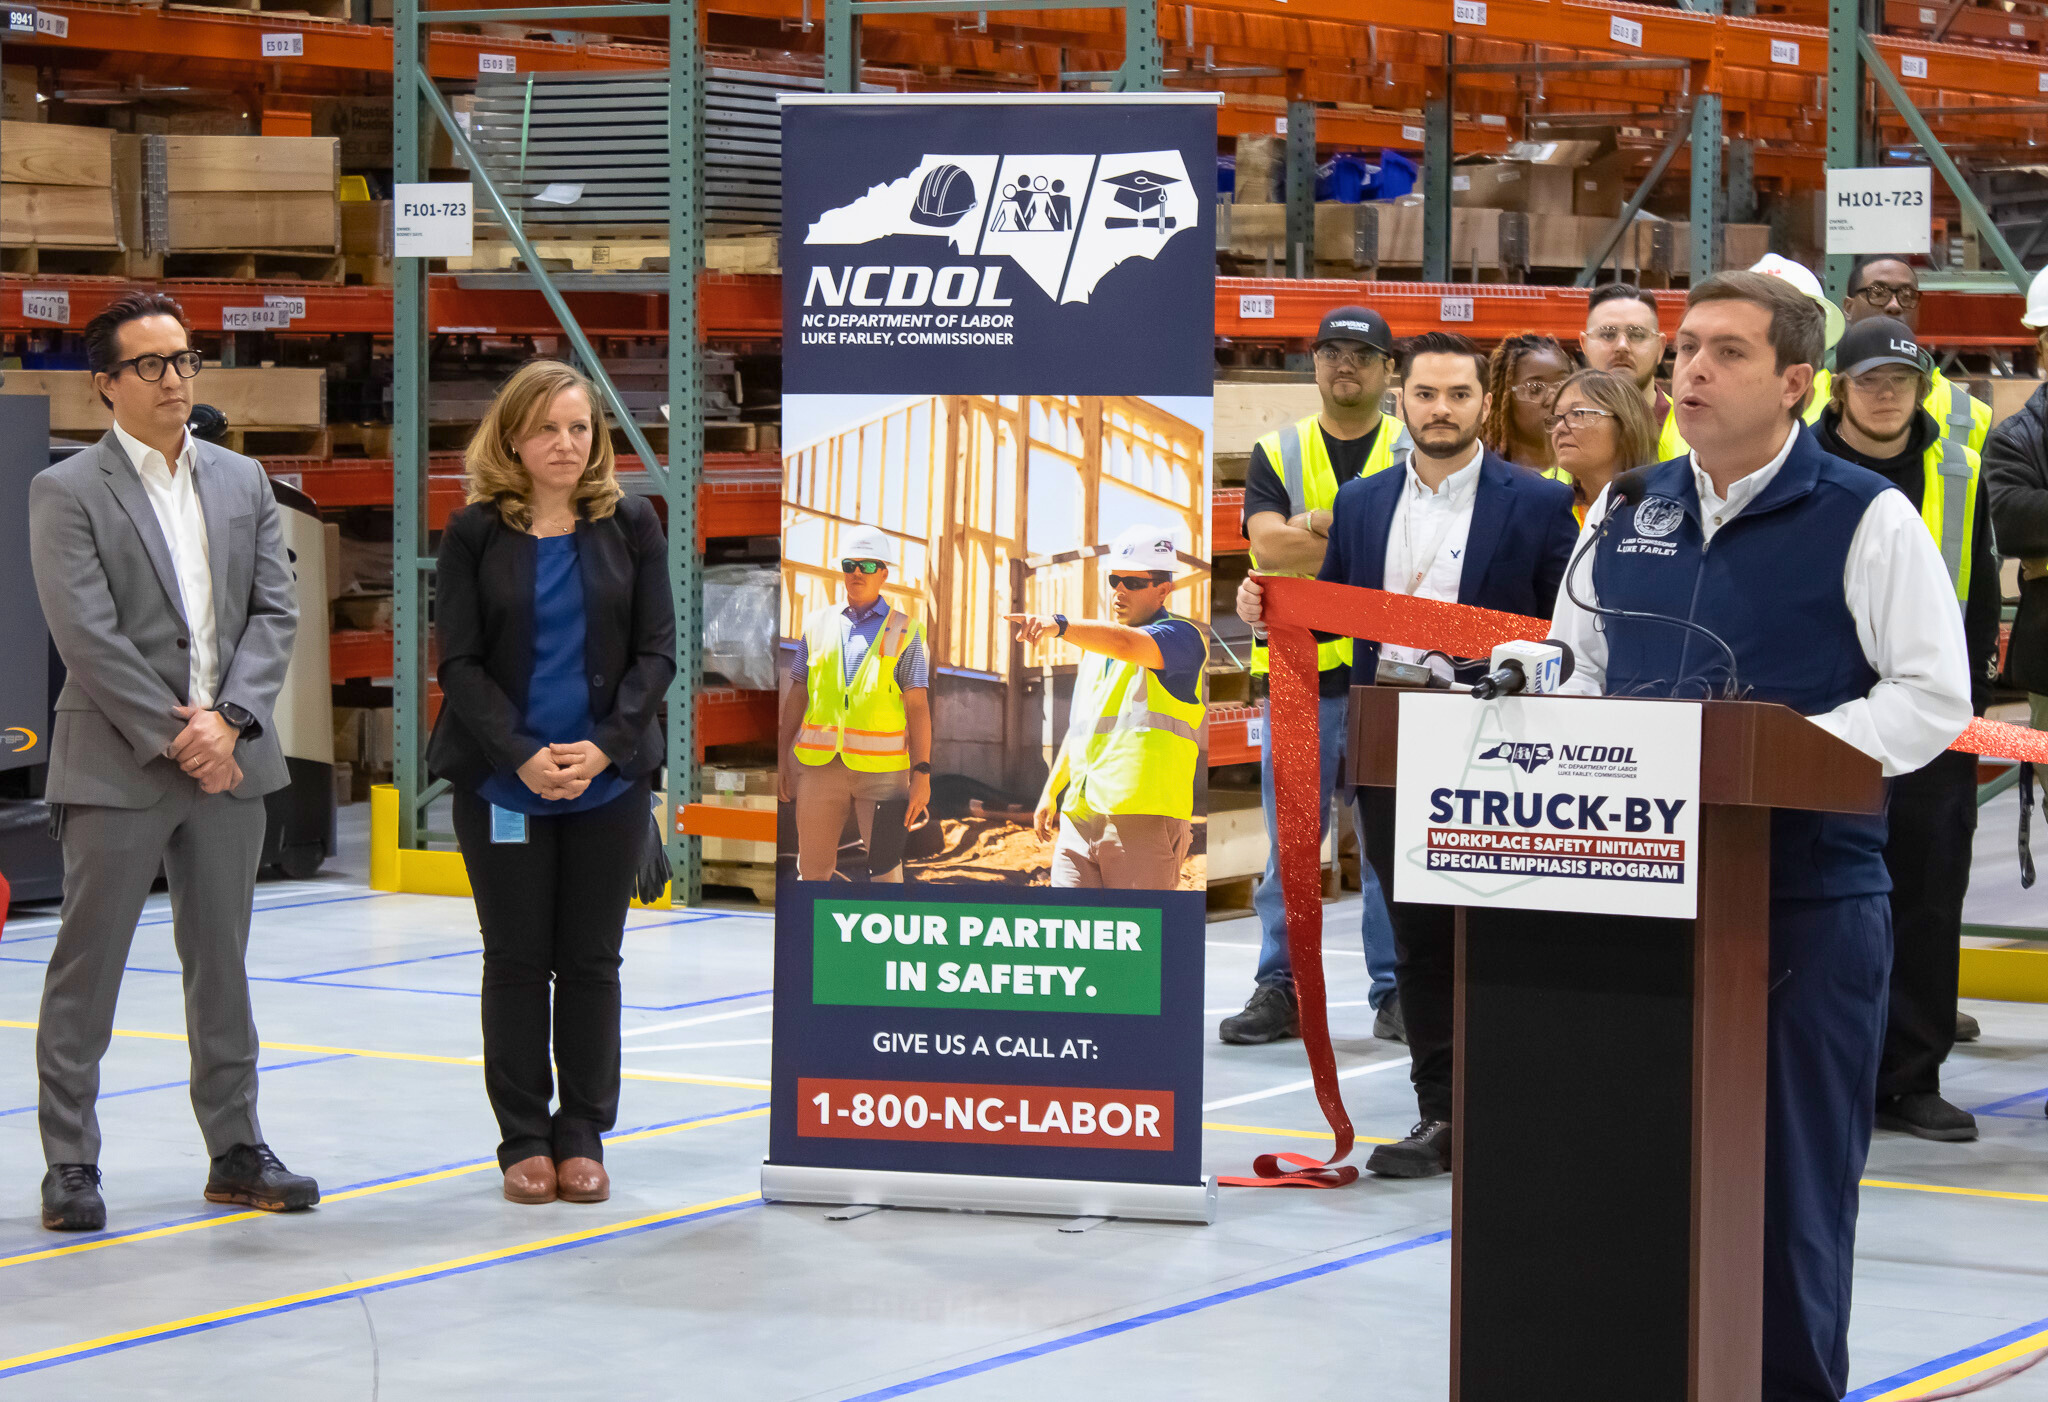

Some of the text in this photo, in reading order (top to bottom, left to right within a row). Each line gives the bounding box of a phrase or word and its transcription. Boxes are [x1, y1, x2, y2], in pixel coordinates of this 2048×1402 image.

[10, 11, 33, 26] 9941
[404, 203, 466, 216] F101-723
[1838, 191, 1924, 207] H101-723
[803, 266, 1013, 306] NCDOL
[802, 314, 1014, 328] NC DEPARTMENT OF LABOR
[802, 333, 1014, 346] LUKE FARLEY, COMMISSIONER
[1559, 745, 1637, 763] NCDOL
[1428, 787, 1687, 834] STRUCK-BY
[1431, 831, 1679, 858] WORKPLACE SAFETY INITIATIVE
[1430, 852, 1678, 880] SPECIAL EMPHASIS PROGRAM
[832, 912, 1142, 951] YOUR PARTNER
[886, 960, 1098, 998] IN SAFETY.
[873, 1032, 1099, 1060] GIVE US A CALL AT:
[812, 1092, 1161, 1138] 1-800-NC-LABOR
